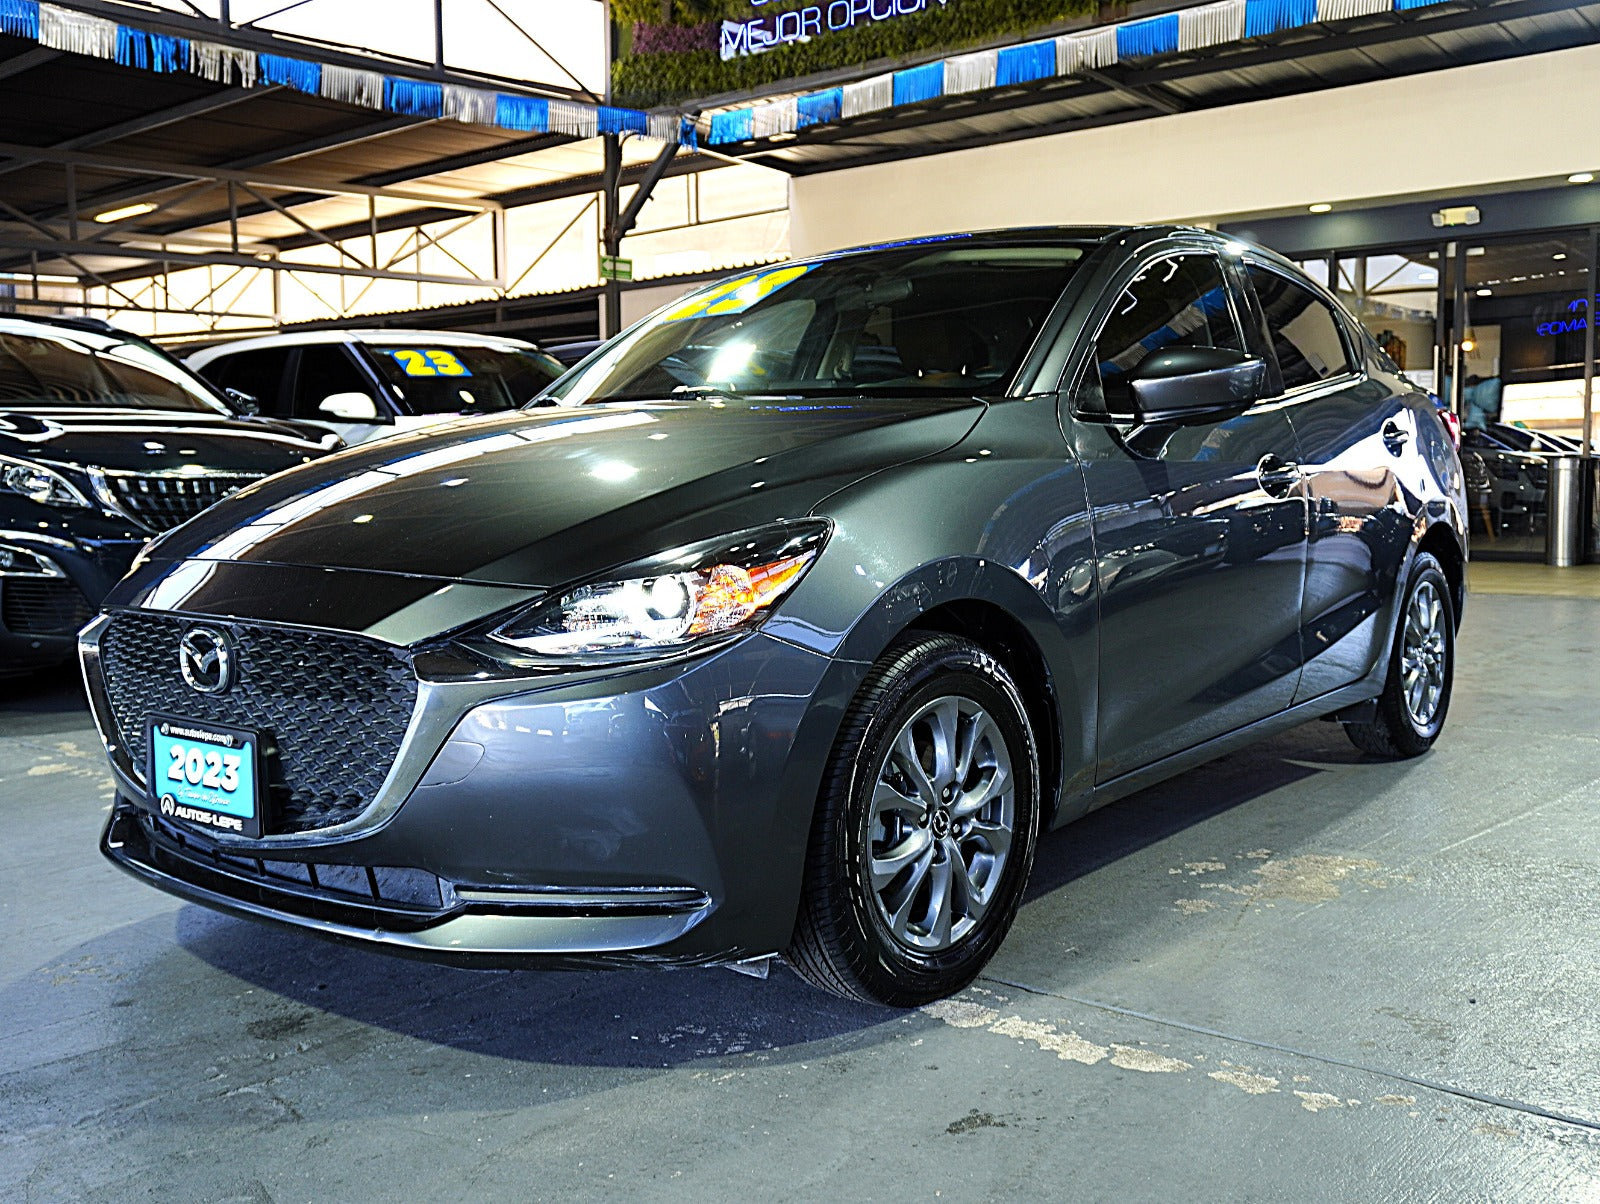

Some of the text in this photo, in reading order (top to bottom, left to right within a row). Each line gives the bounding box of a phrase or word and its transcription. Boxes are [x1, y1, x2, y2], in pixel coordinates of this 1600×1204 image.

[721, 0, 947, 55] MEJOR OPCIO
[393, 349, 465, 376] 23
[167, 744, 241, 792] 2023
